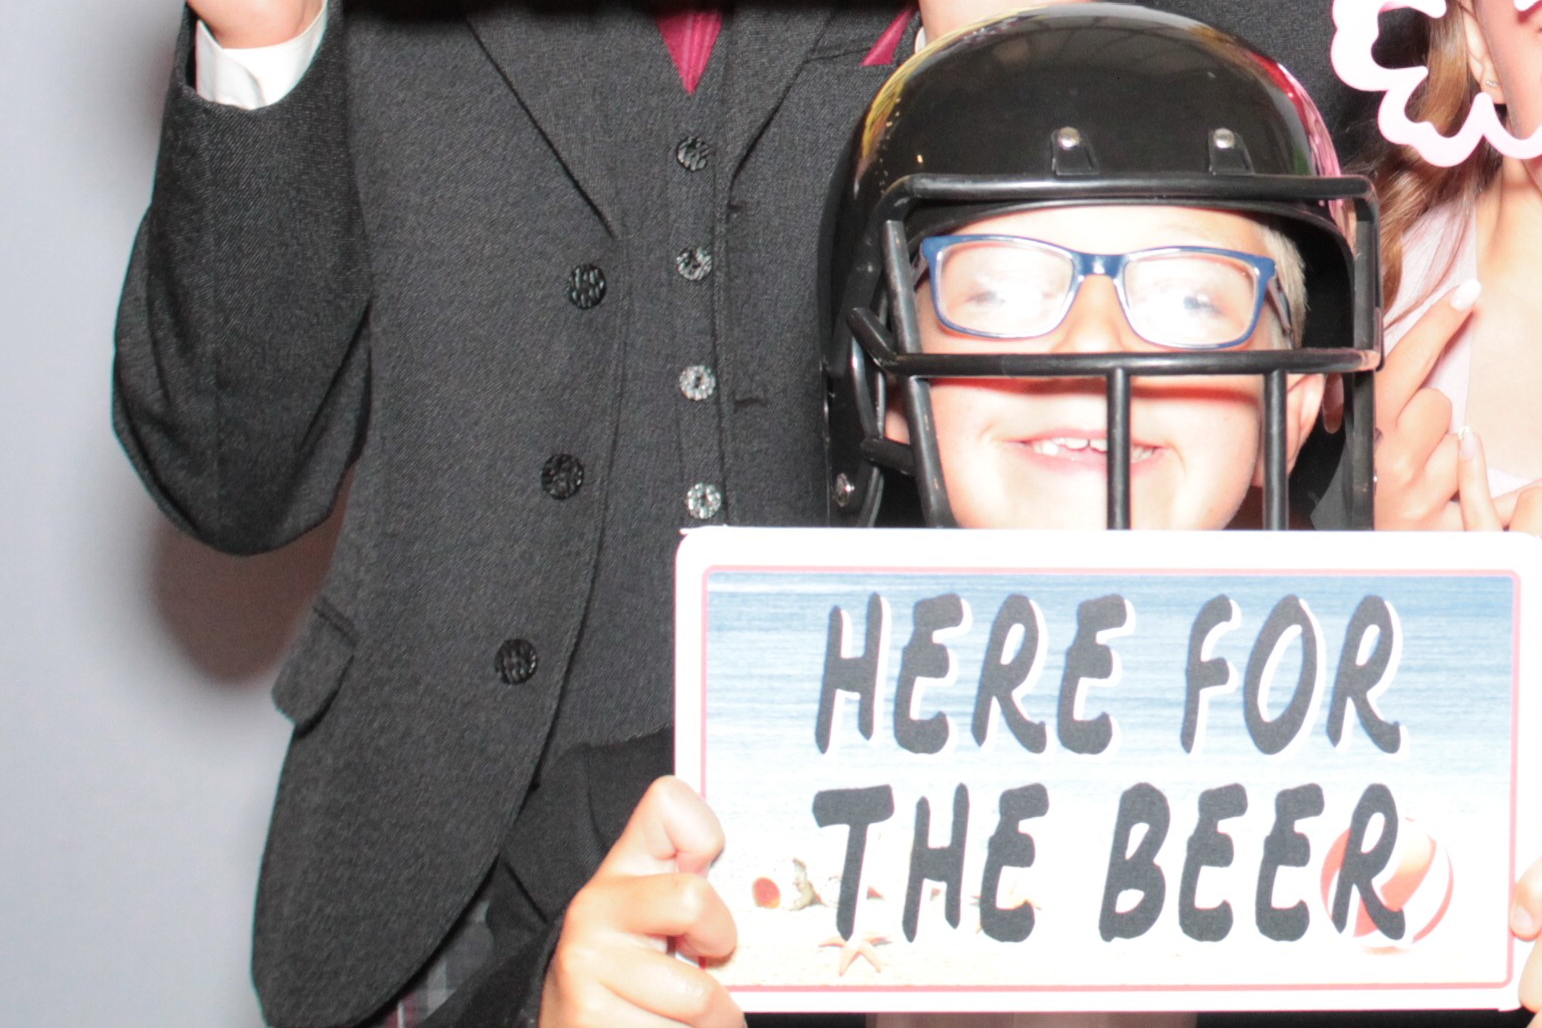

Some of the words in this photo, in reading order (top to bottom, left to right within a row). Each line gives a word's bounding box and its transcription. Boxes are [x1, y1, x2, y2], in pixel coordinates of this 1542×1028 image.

[815, 592, 1126, 755] HERE
[1181, 594, 1402, 755] FOR
[812, 783, 1050, 943] THE
[1100, 783, 1406, 943] BEER
